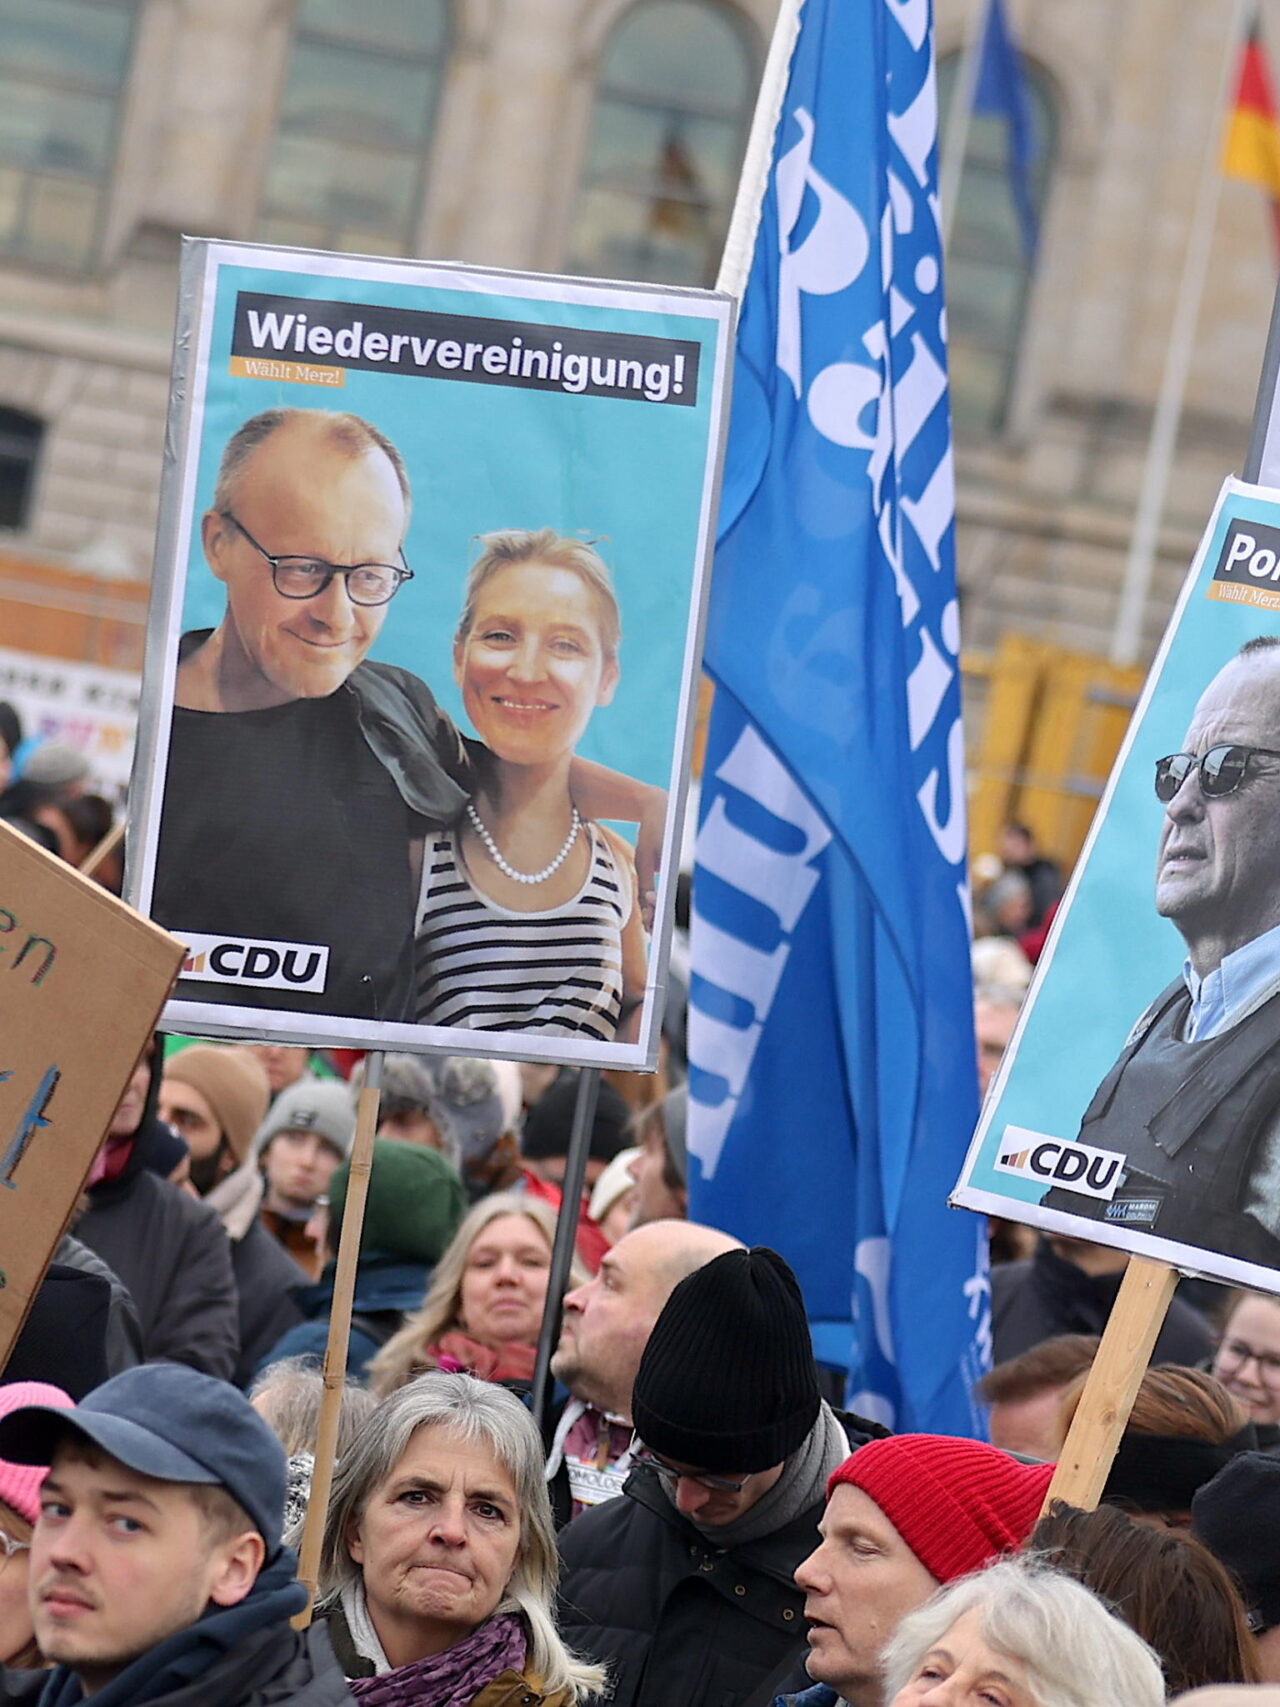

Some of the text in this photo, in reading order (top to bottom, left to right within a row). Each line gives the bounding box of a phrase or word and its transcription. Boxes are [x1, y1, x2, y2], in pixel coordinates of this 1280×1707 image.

[244, 359, 341, 385] Wählt Merz!
[246, 310, 687, 403] Wiedervereinigung!
[209, 943, 322, 983] CDU
[1030, 1142, 1120, 1190] CDU
